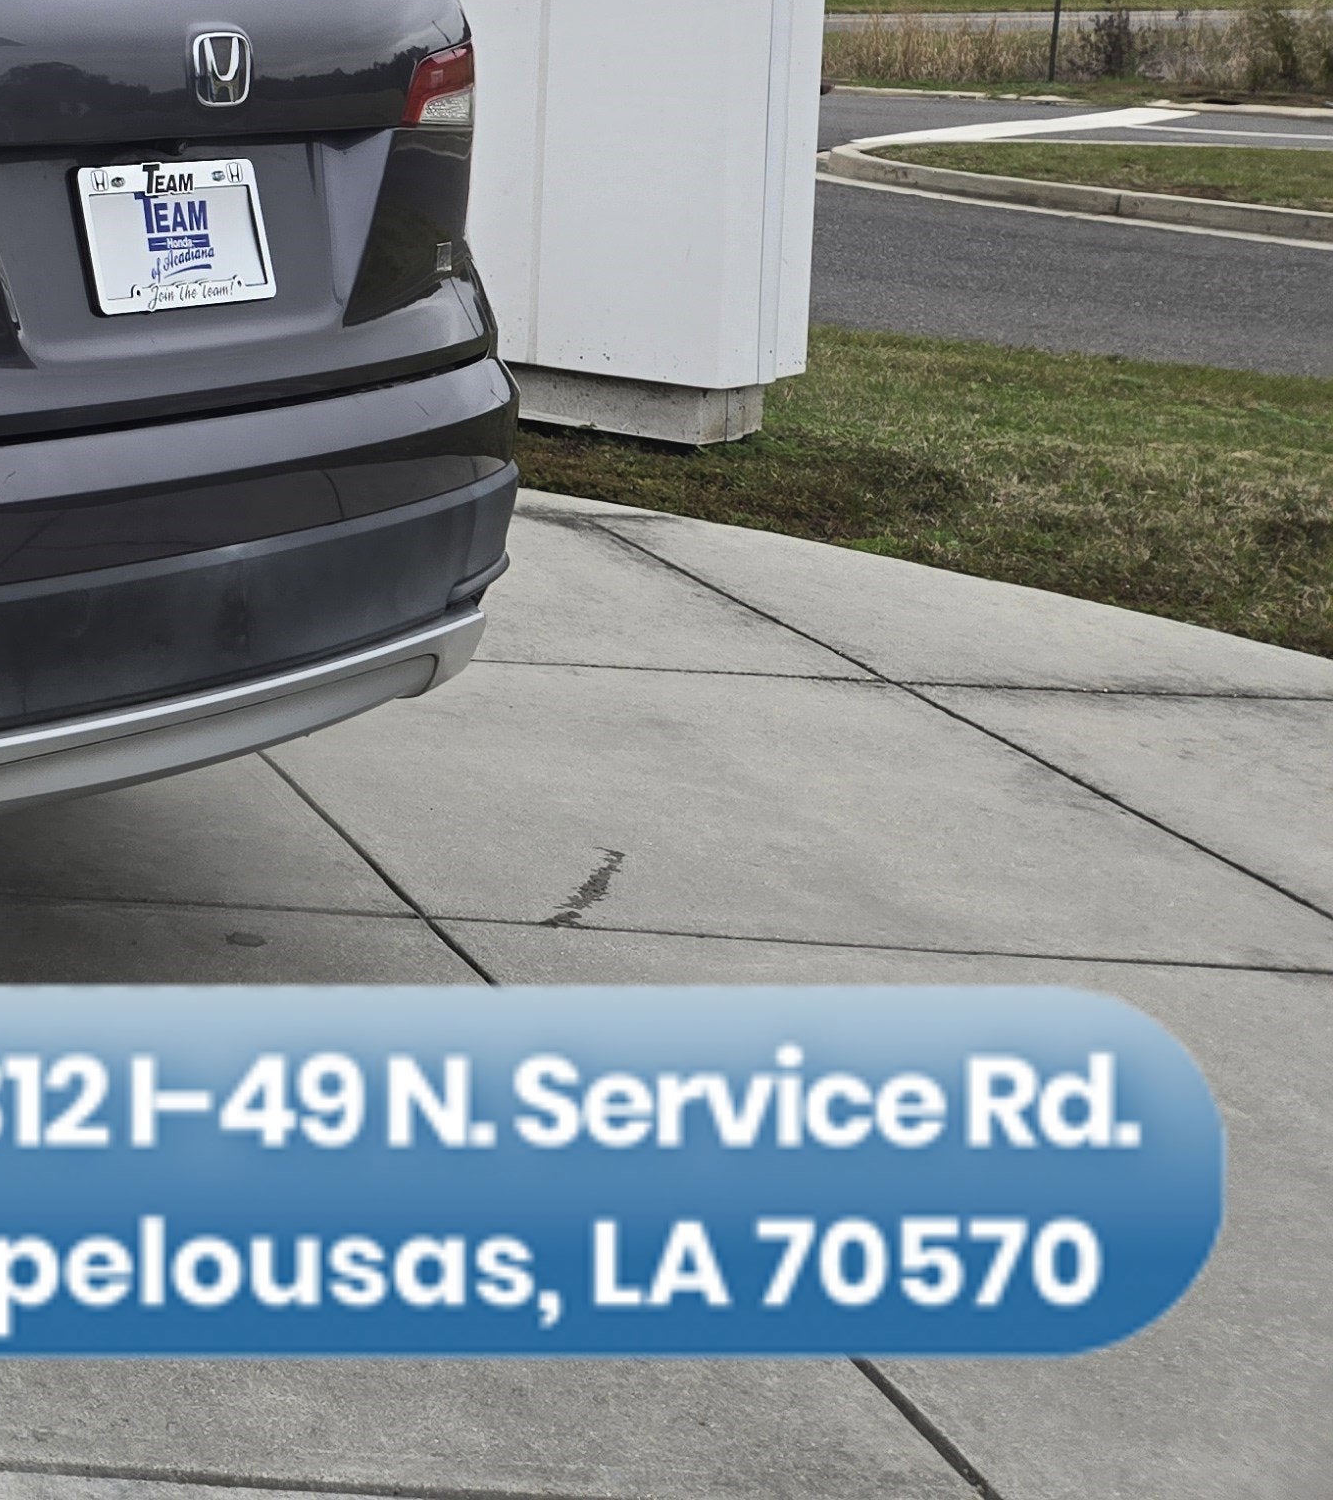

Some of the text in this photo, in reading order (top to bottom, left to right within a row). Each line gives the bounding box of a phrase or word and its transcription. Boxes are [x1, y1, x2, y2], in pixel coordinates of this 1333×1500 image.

[142, 163, 194, 194] TEAM
[133, 191, 208, 234] TEAM
[151, 247, 215, 283] of Acadiana
[148, 285, 174, 310] Join
